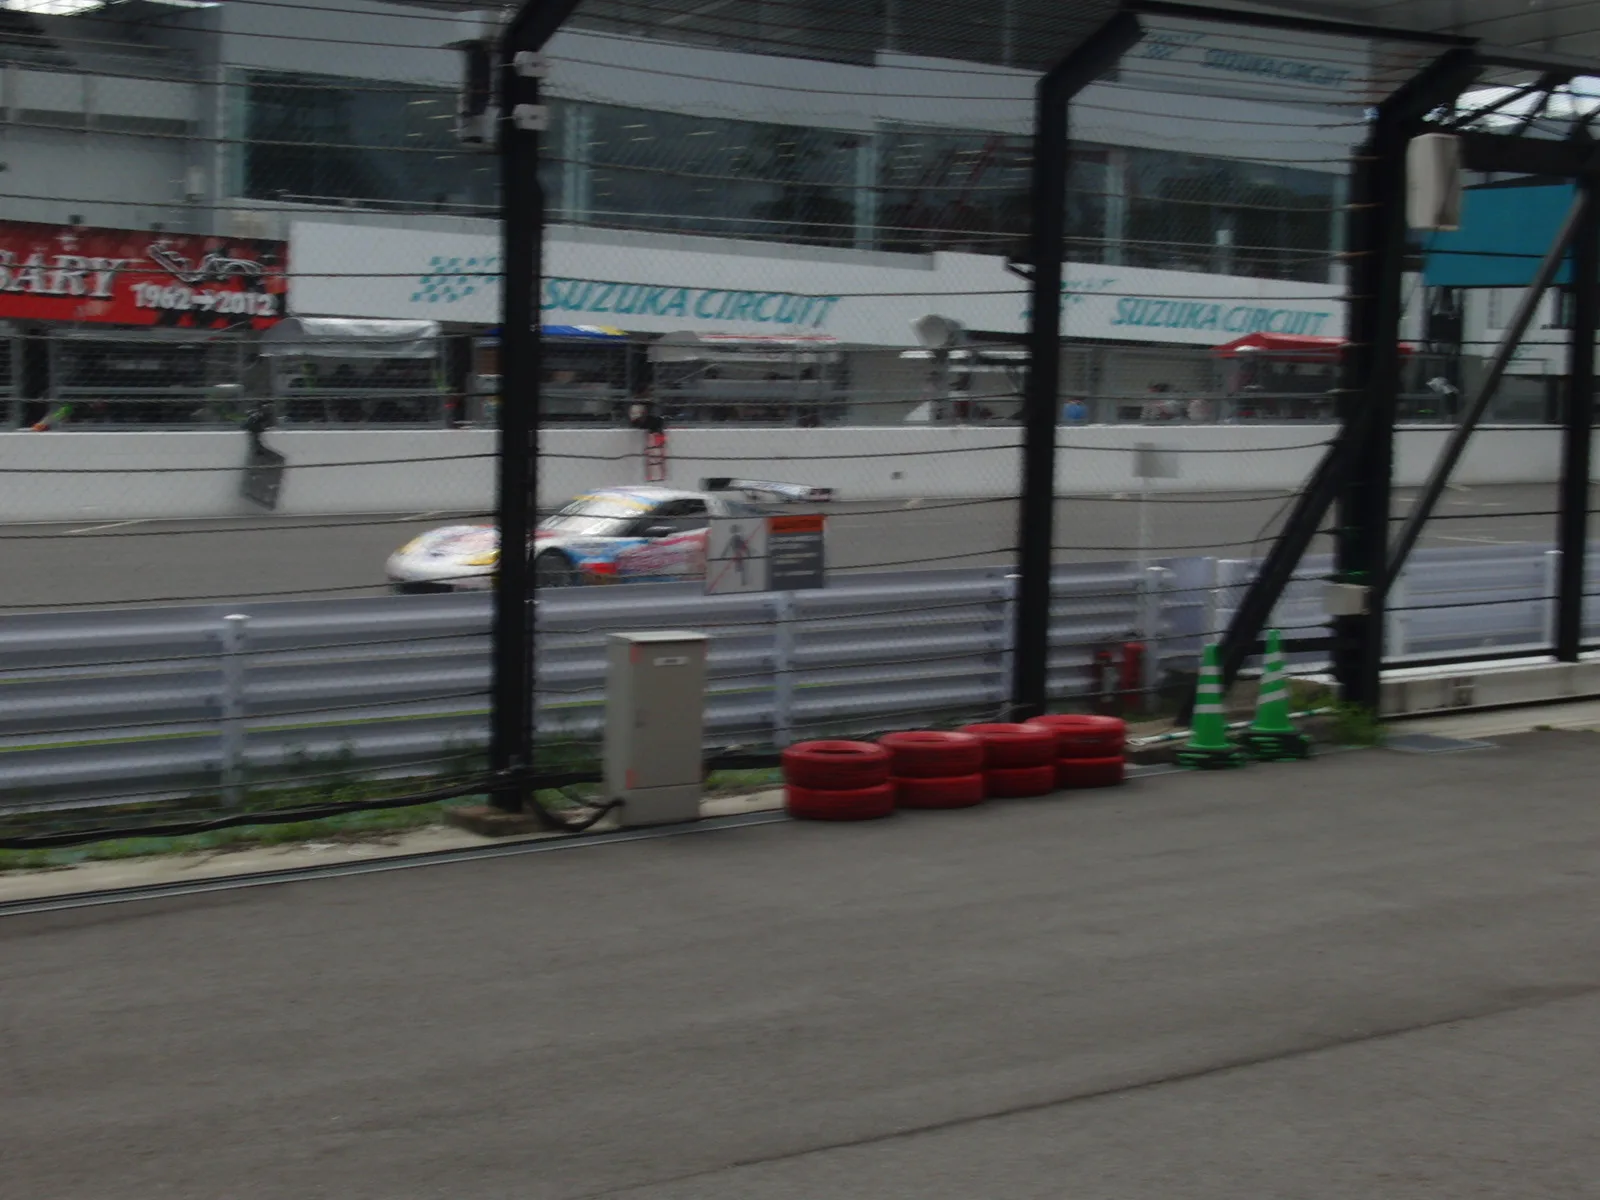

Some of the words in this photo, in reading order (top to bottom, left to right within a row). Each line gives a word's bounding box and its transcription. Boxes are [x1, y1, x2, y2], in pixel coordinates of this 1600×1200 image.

[539, 278, 688, 317] SUZUKA
[692, 287, 840, 328] CIRCUIT
[1111, 296, 1220, 330] SUZUKA
[1223, 306, 1330, 337] CIRCUIT
